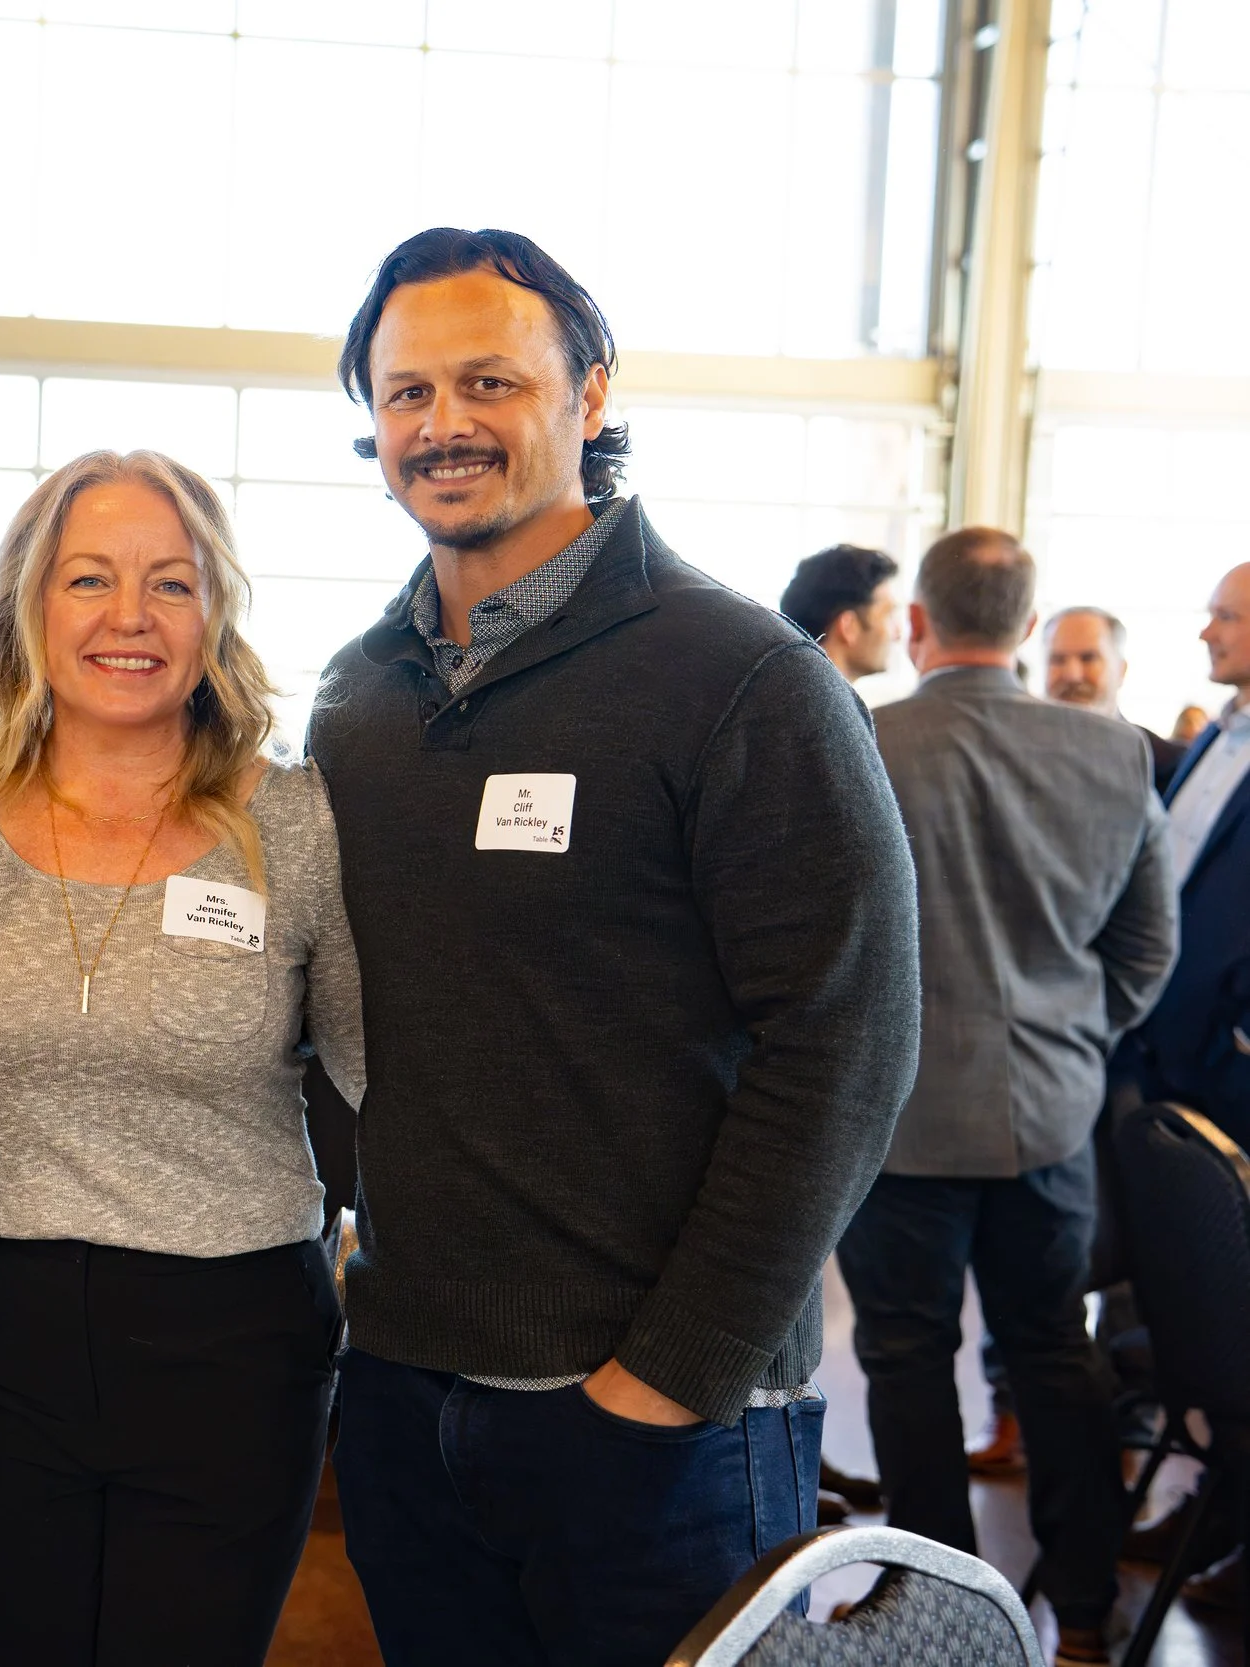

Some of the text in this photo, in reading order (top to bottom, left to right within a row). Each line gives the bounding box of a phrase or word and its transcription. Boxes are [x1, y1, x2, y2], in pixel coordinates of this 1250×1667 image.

[518, 789, 532, 798] Mr.
[513, 802, 533, 813] Cliff
[496, 817, 548, 830] Van Rickley
[206, 895, 228, 906] Mrs.
[196, 904, 237, 918] Jennifer
[186, 913, 244, 933] Van Rickley
